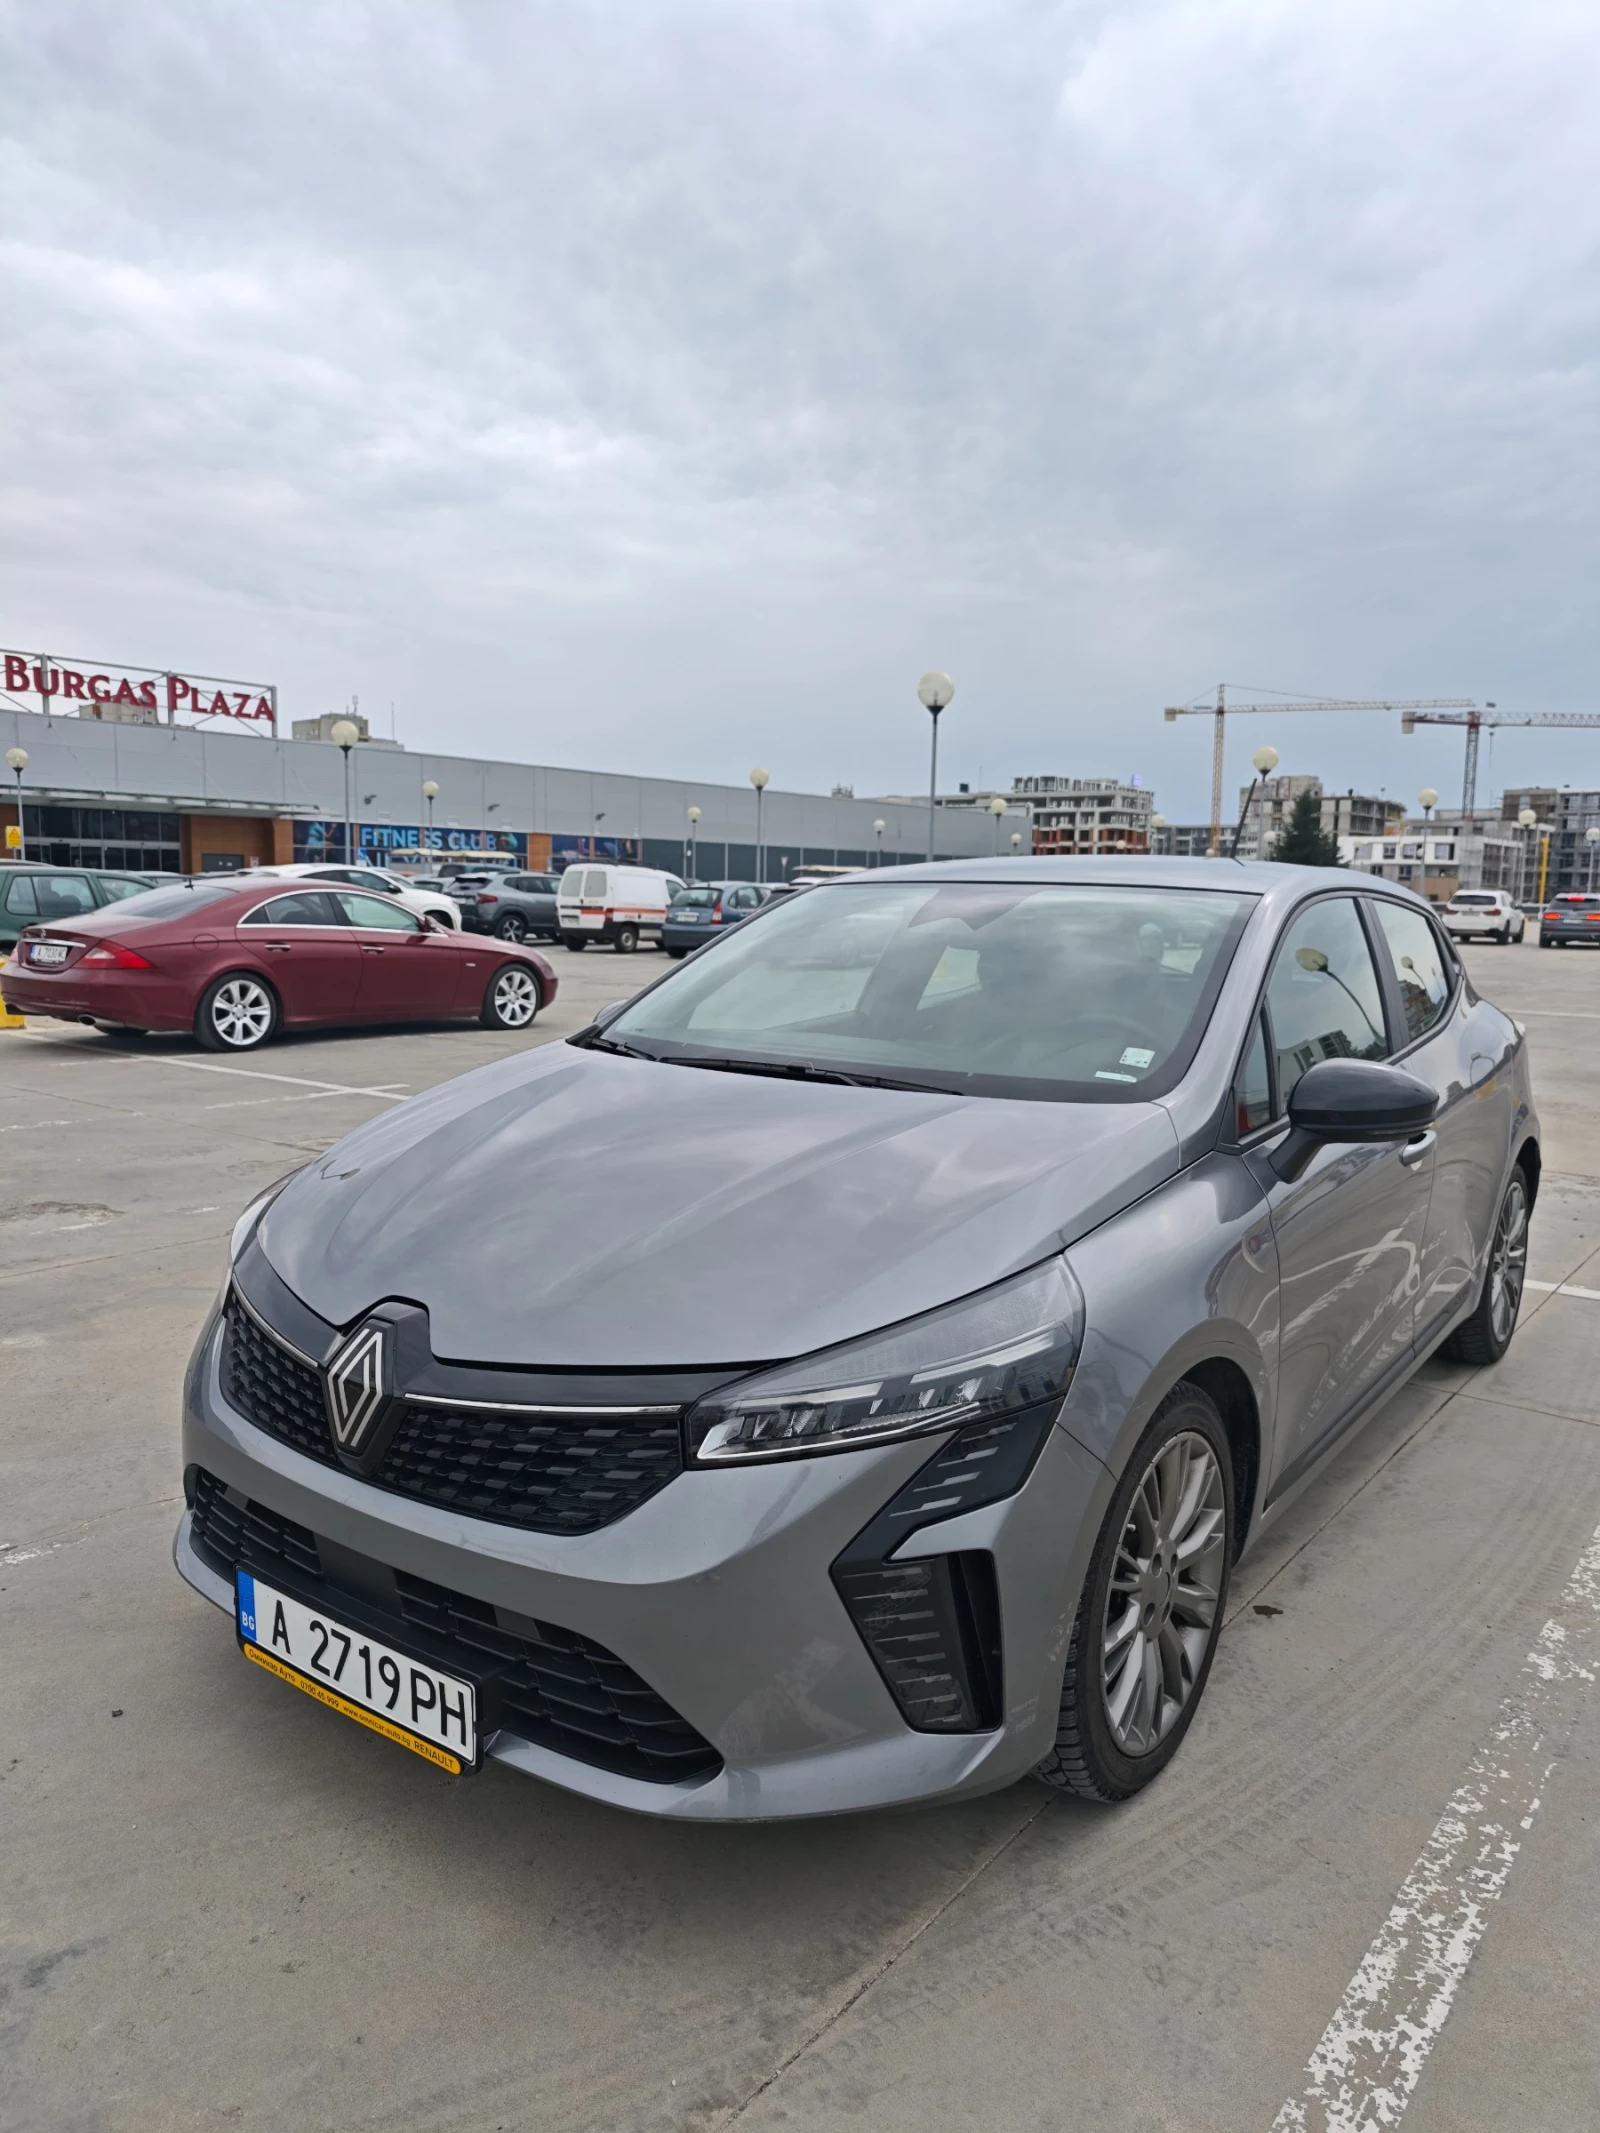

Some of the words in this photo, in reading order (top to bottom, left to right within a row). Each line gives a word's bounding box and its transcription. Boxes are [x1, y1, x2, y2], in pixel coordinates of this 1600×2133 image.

[361, 827, 443, 850] FITNESS
[448, 831, 498, 851] CLUB
[241, 1611, 255, 1631] BG
[272, 1599, 292, 1655] A
[414, 1740, 455, 1769] RENAULT
